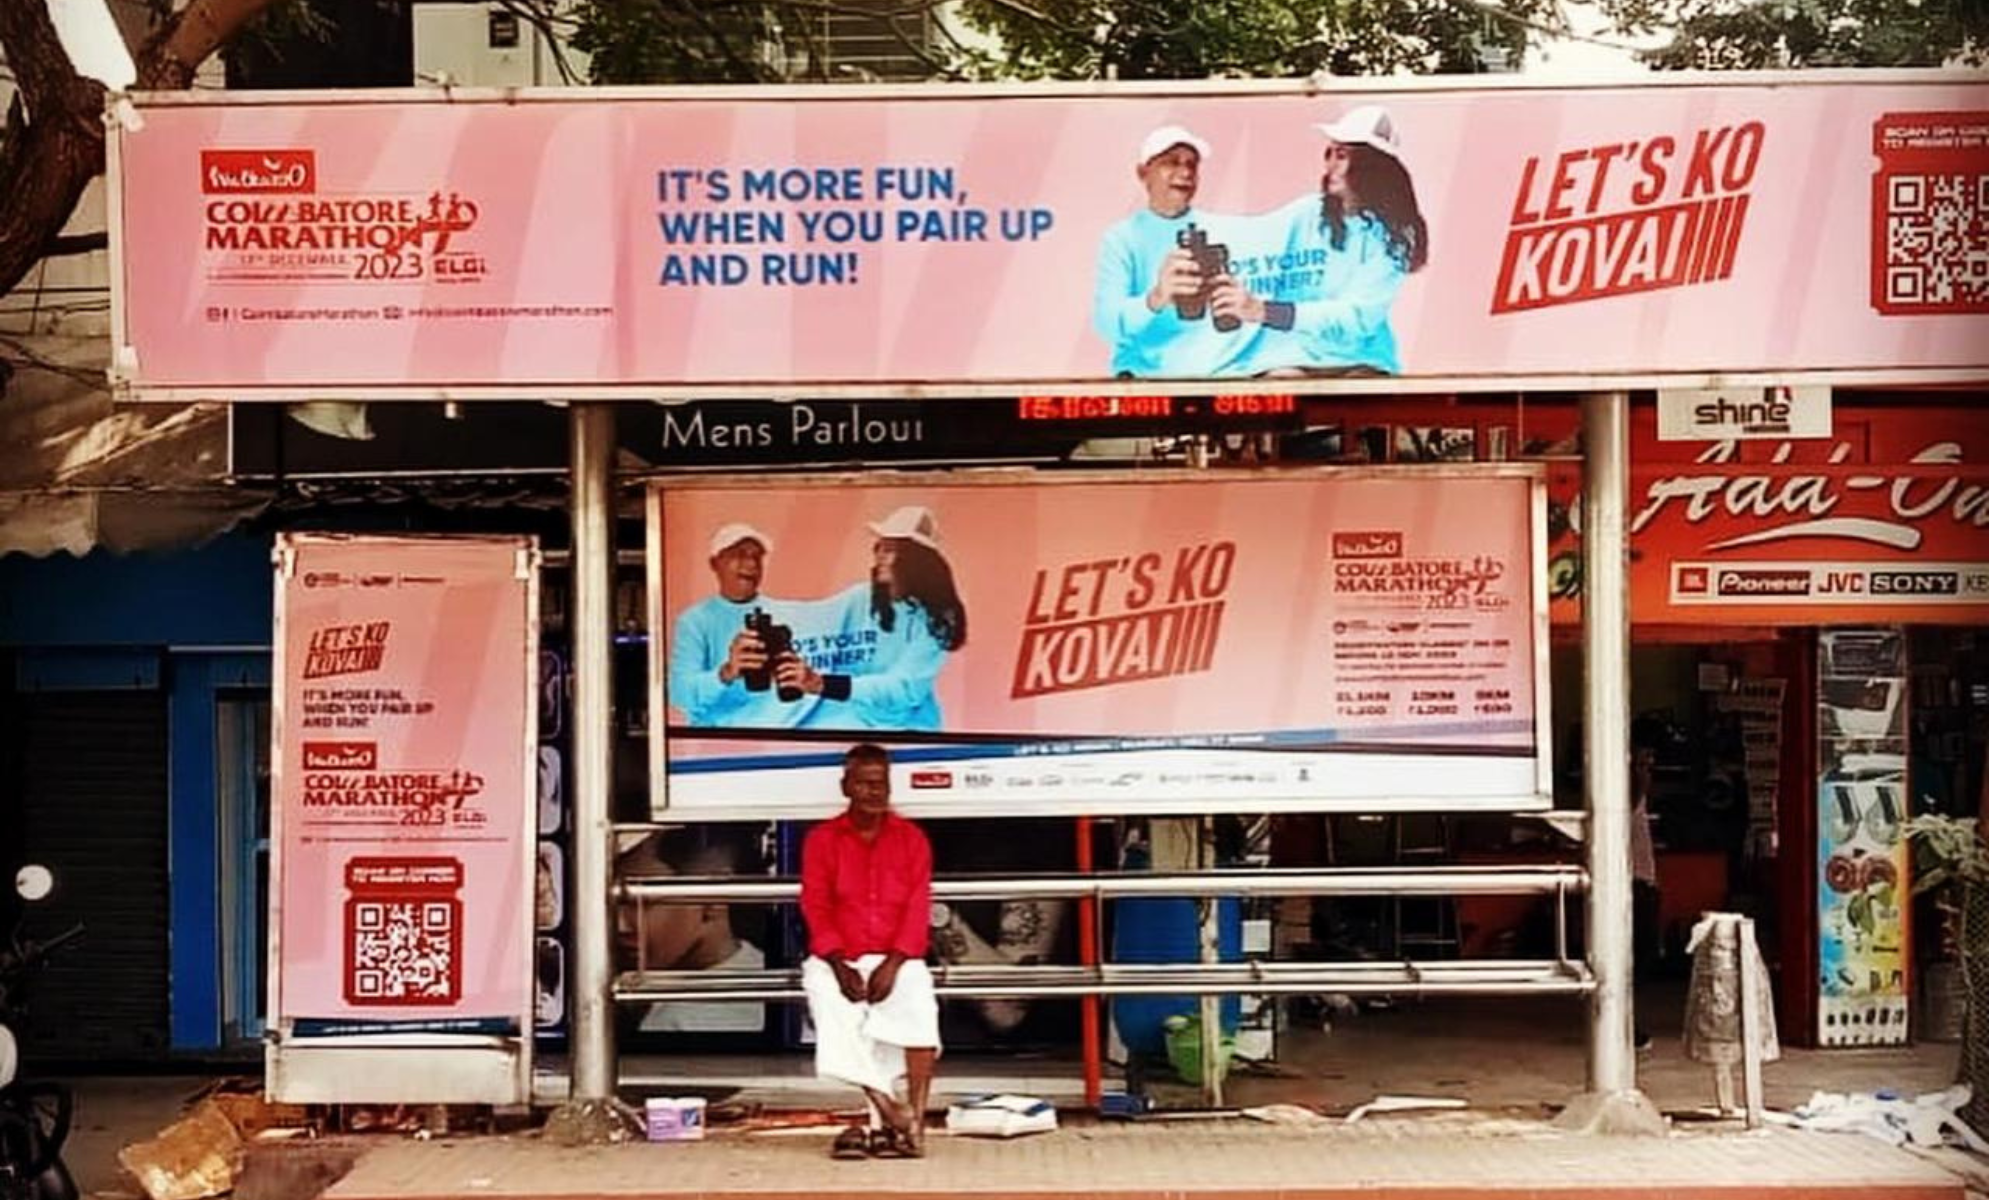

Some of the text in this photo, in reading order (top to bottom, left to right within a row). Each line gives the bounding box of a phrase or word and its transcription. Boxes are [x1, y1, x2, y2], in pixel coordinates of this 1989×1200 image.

[657, 168, 967, 205] IT'S MORE FUN,
[1511, 121, 1766, 226] LET'S KO
[206, 225, 422, 250] MARATHON
[656, 209, 1053, 243] WHEN YOU PAIR UP
[354, 252, 423, 279] 2023
[659, 252, 858, 286] AND RUN!
[1506, 209, 1691, 301] KOVAI
[662, 408, 772, 448] Mens
[1025, 541, 1237, 625] LET'S KO
[1333, 577, 1471, 594] MARATHON
[1720, 571, 1809, 593] Pioneer
[1817, 572, 1865, 593] JVC
[1873, 575, 1954, 591] SONY
[823, 630, 878, 650] YOUR
[1022, 613, 1175, 692] KOVAI
[349, 703, 379, 714] YOU
[303, 790, 447, 807] MARATHON
